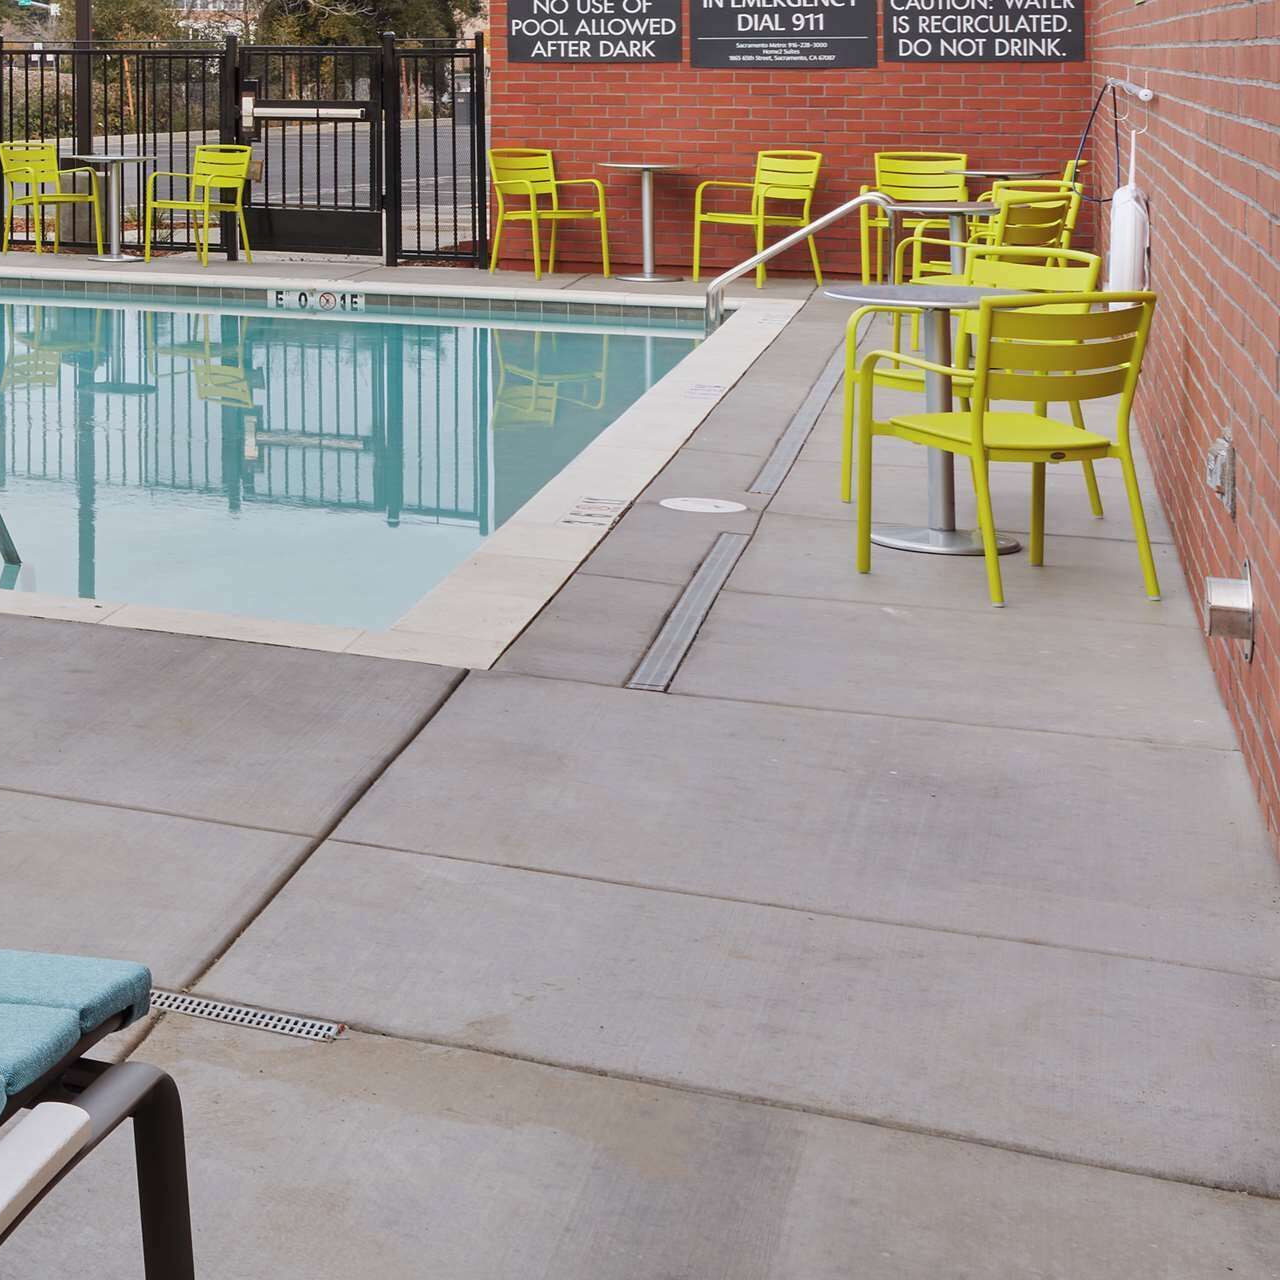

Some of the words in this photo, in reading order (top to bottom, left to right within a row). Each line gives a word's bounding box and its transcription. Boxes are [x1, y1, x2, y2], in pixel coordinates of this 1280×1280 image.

[511, 18, 569, 36] POOL
[574, 17, 677, 36] ALLOWED
[737, 13, 786, 32] DIAL
[791, 13, 824, 31] 911
[892, 15, 910, 34] IS
[918, 13, 1072, 34] RECIRCULATED.
[530, 40, 592, 58] AFTER
[599, 40, 656, 58] DARK
[898, 38, 932, 57] DO
[940, 38, 987, 57] NOT
[994, 38, 1067, 57] DRINK.
